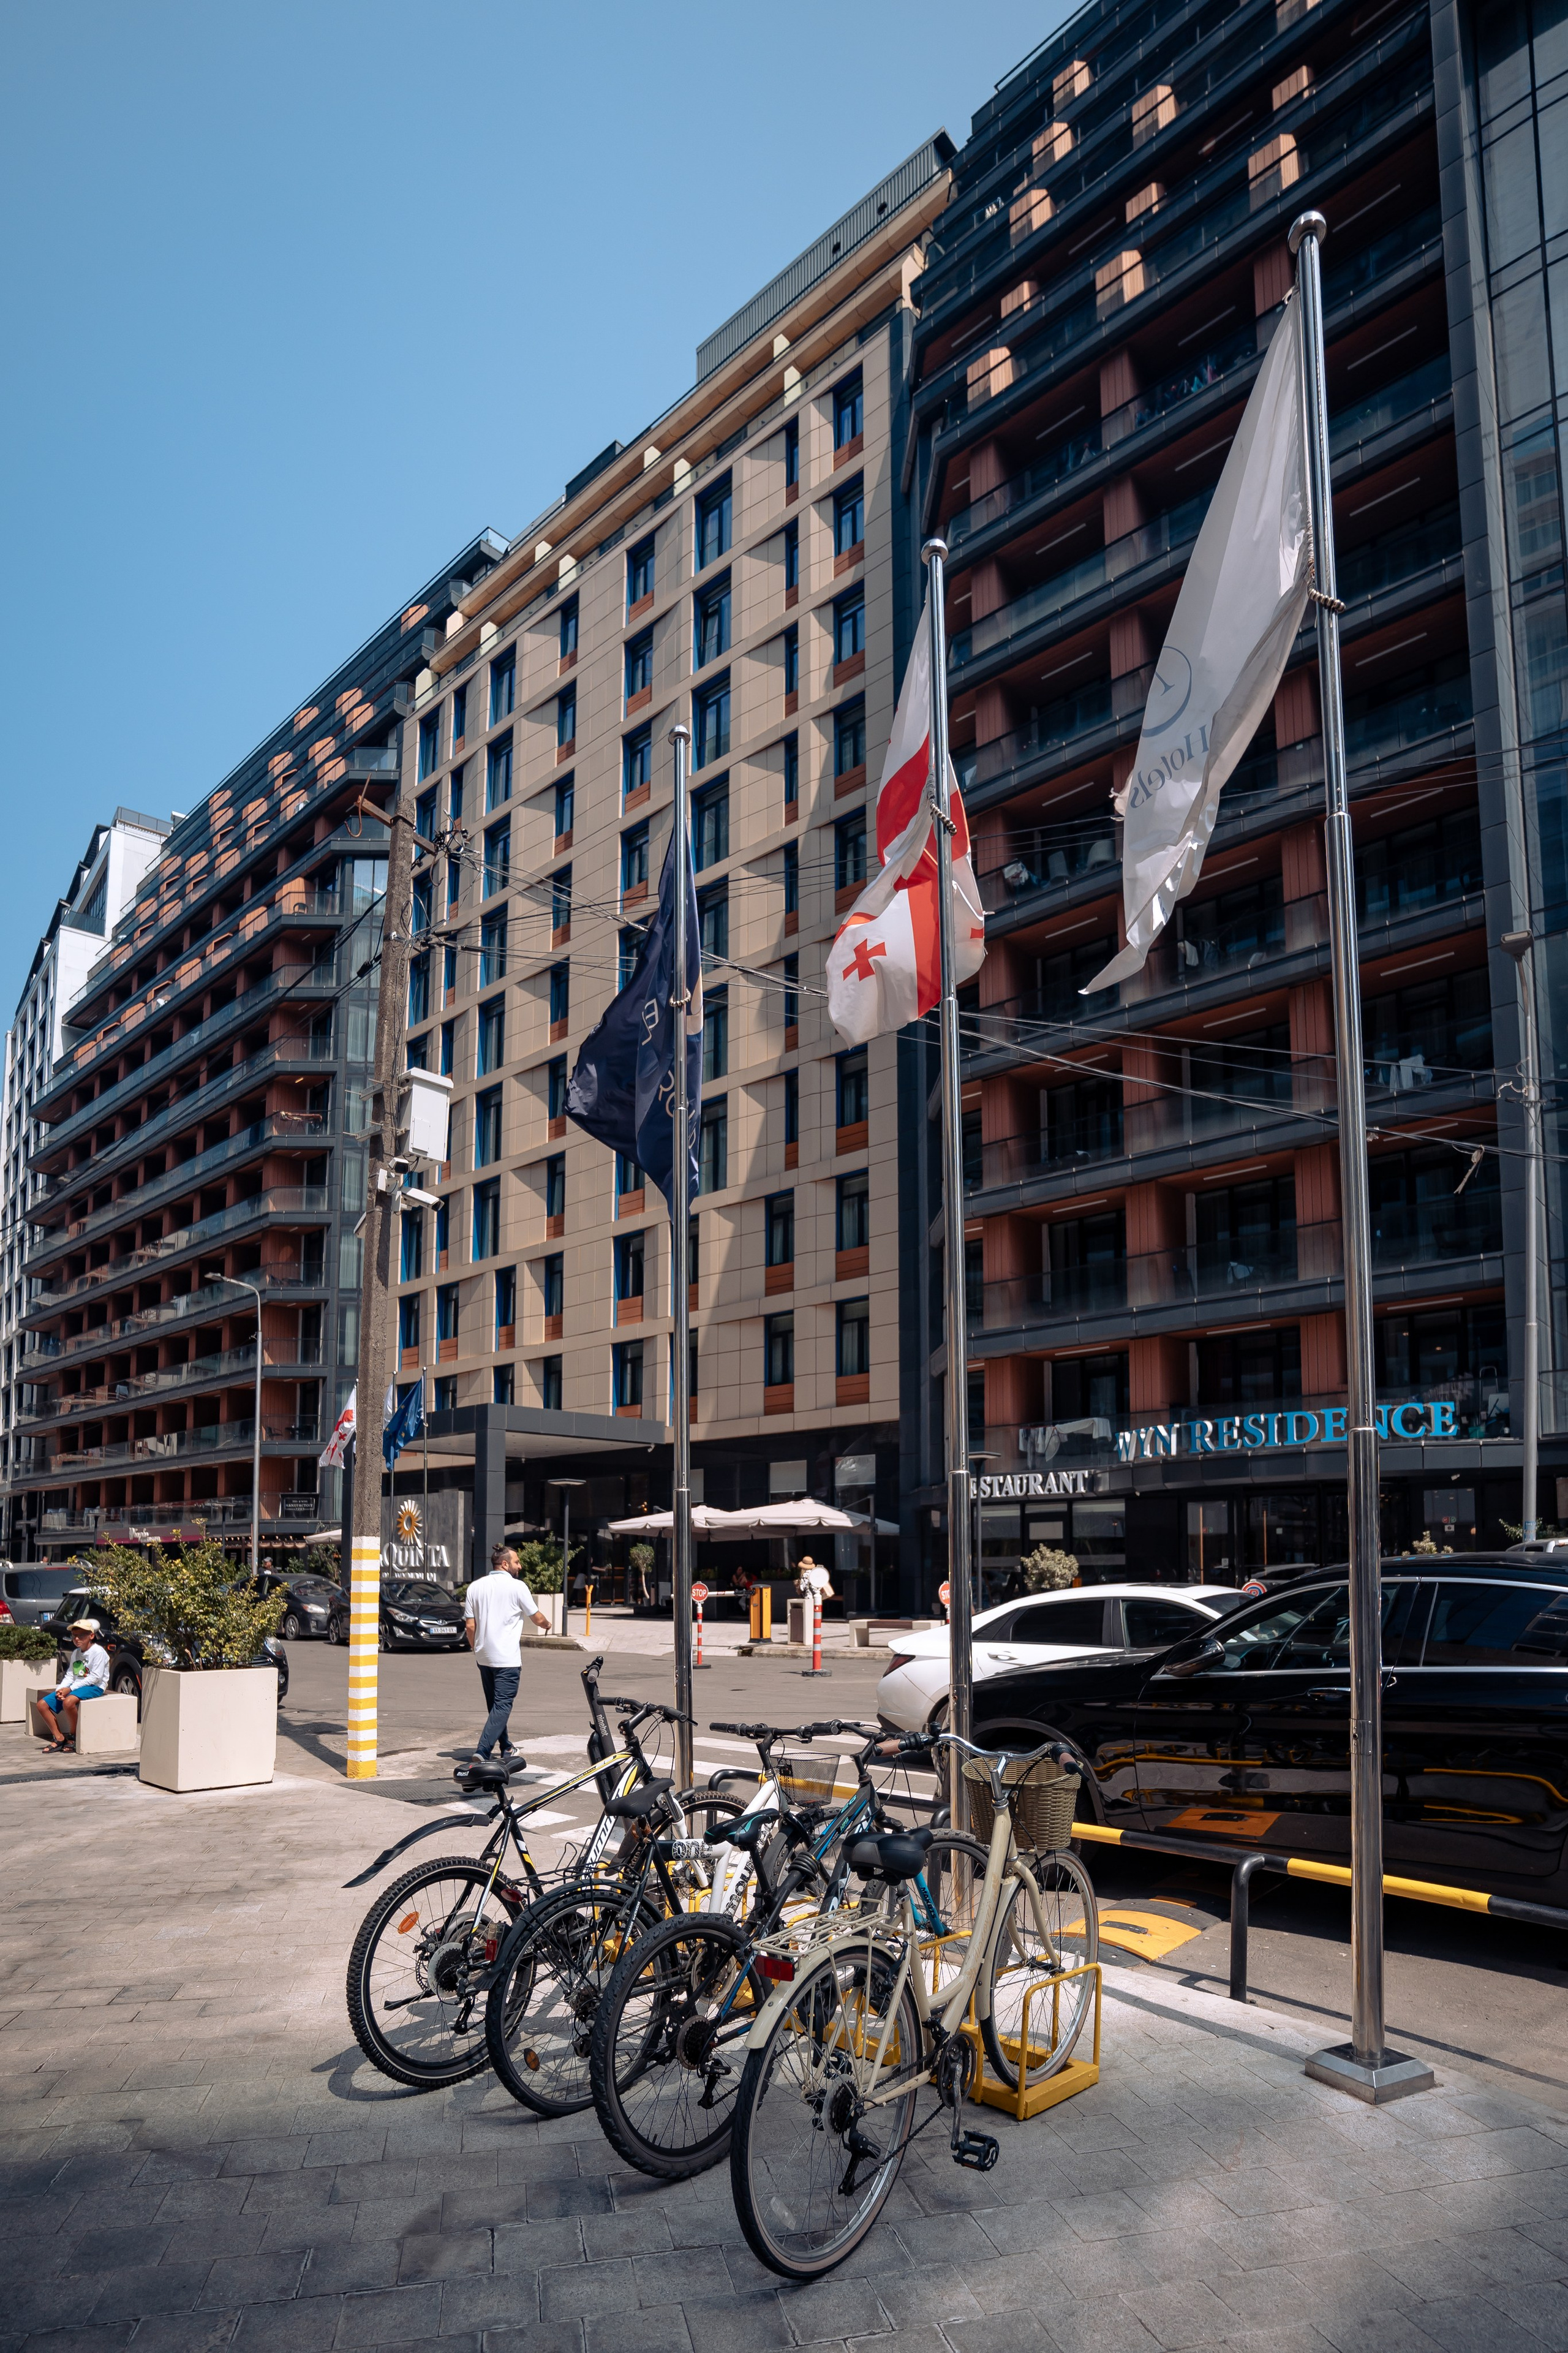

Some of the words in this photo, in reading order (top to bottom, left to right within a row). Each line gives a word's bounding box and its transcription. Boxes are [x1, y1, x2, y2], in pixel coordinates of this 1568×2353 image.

[1115, 1423, 1180, 1462] WYN
[970, 1470, 1088, 1499] ESTAURANT
[692, 1588, 707, 1597] STOP
[596, 1714, 609, 1737] ninebot
